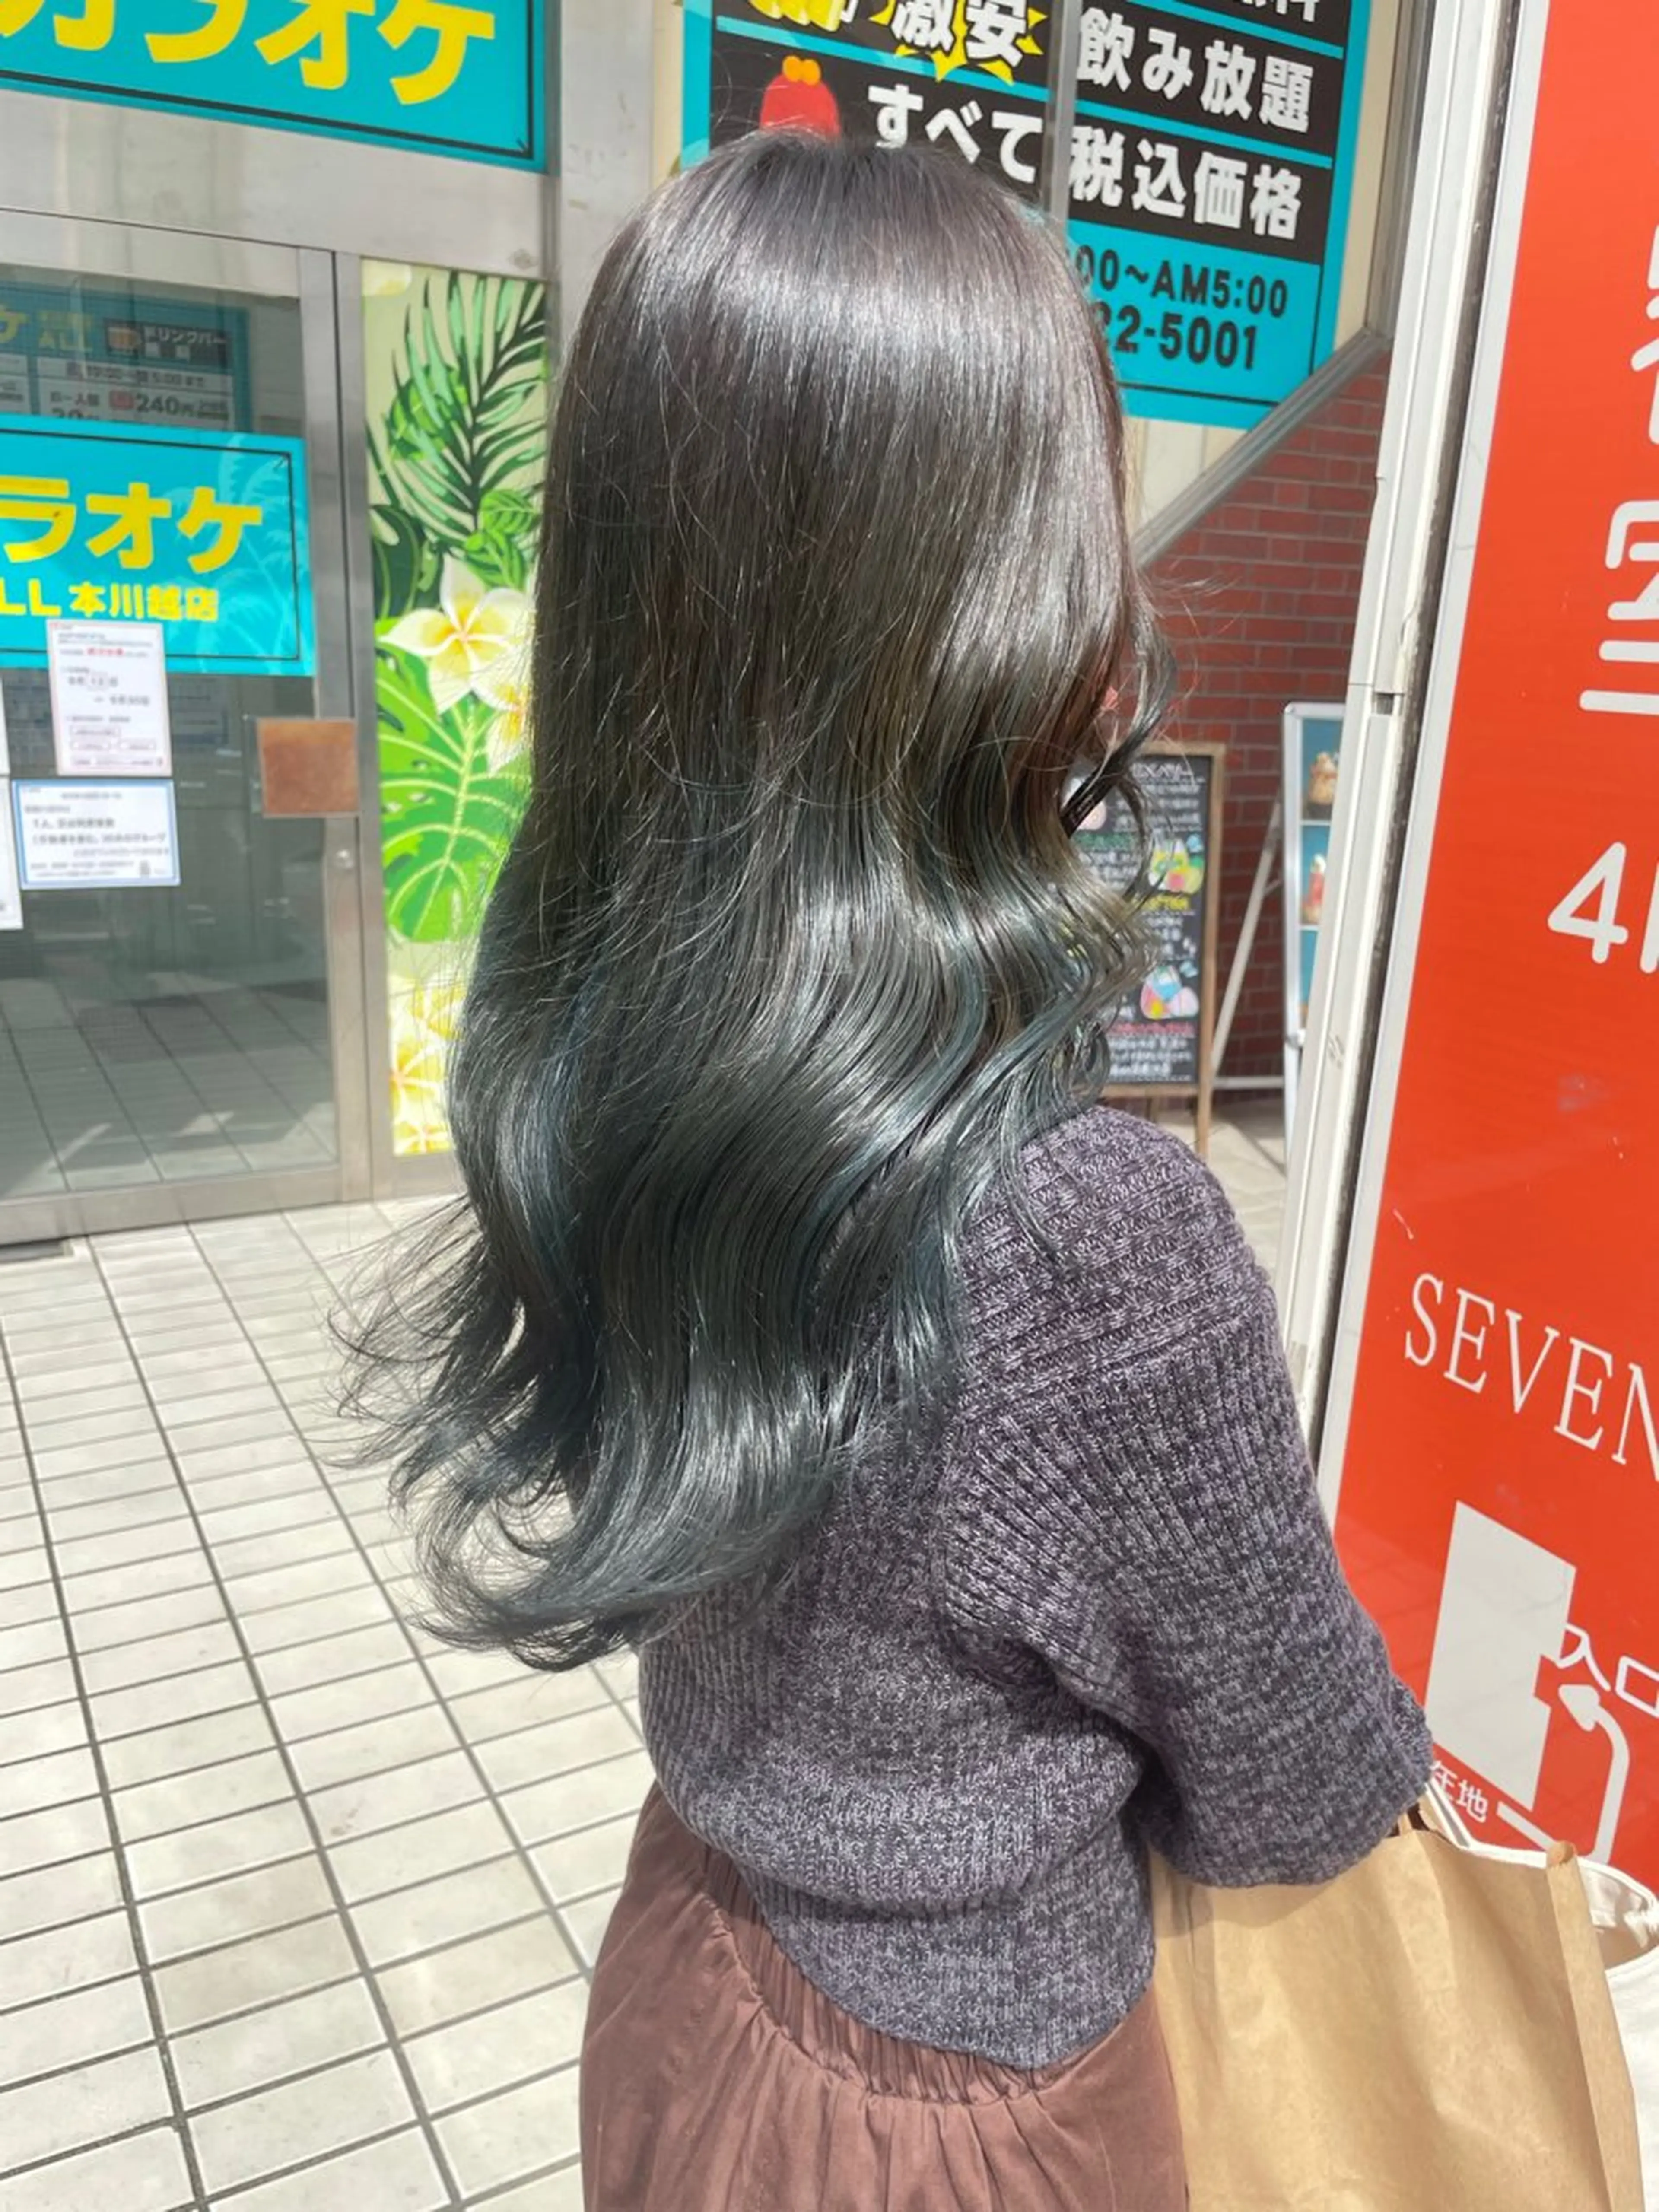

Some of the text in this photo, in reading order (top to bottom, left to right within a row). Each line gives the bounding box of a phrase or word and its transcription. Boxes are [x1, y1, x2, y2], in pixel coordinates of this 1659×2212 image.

[1077, 6, 1314, 133] 飲み放題
[868, 84, 1301, 240] すべて 税込価格
[0, 476, 263, 574] ラオケ
[69, 581, 218, 622] 本川越店
[1405, 1273, 1659, 1483] SEVEN
